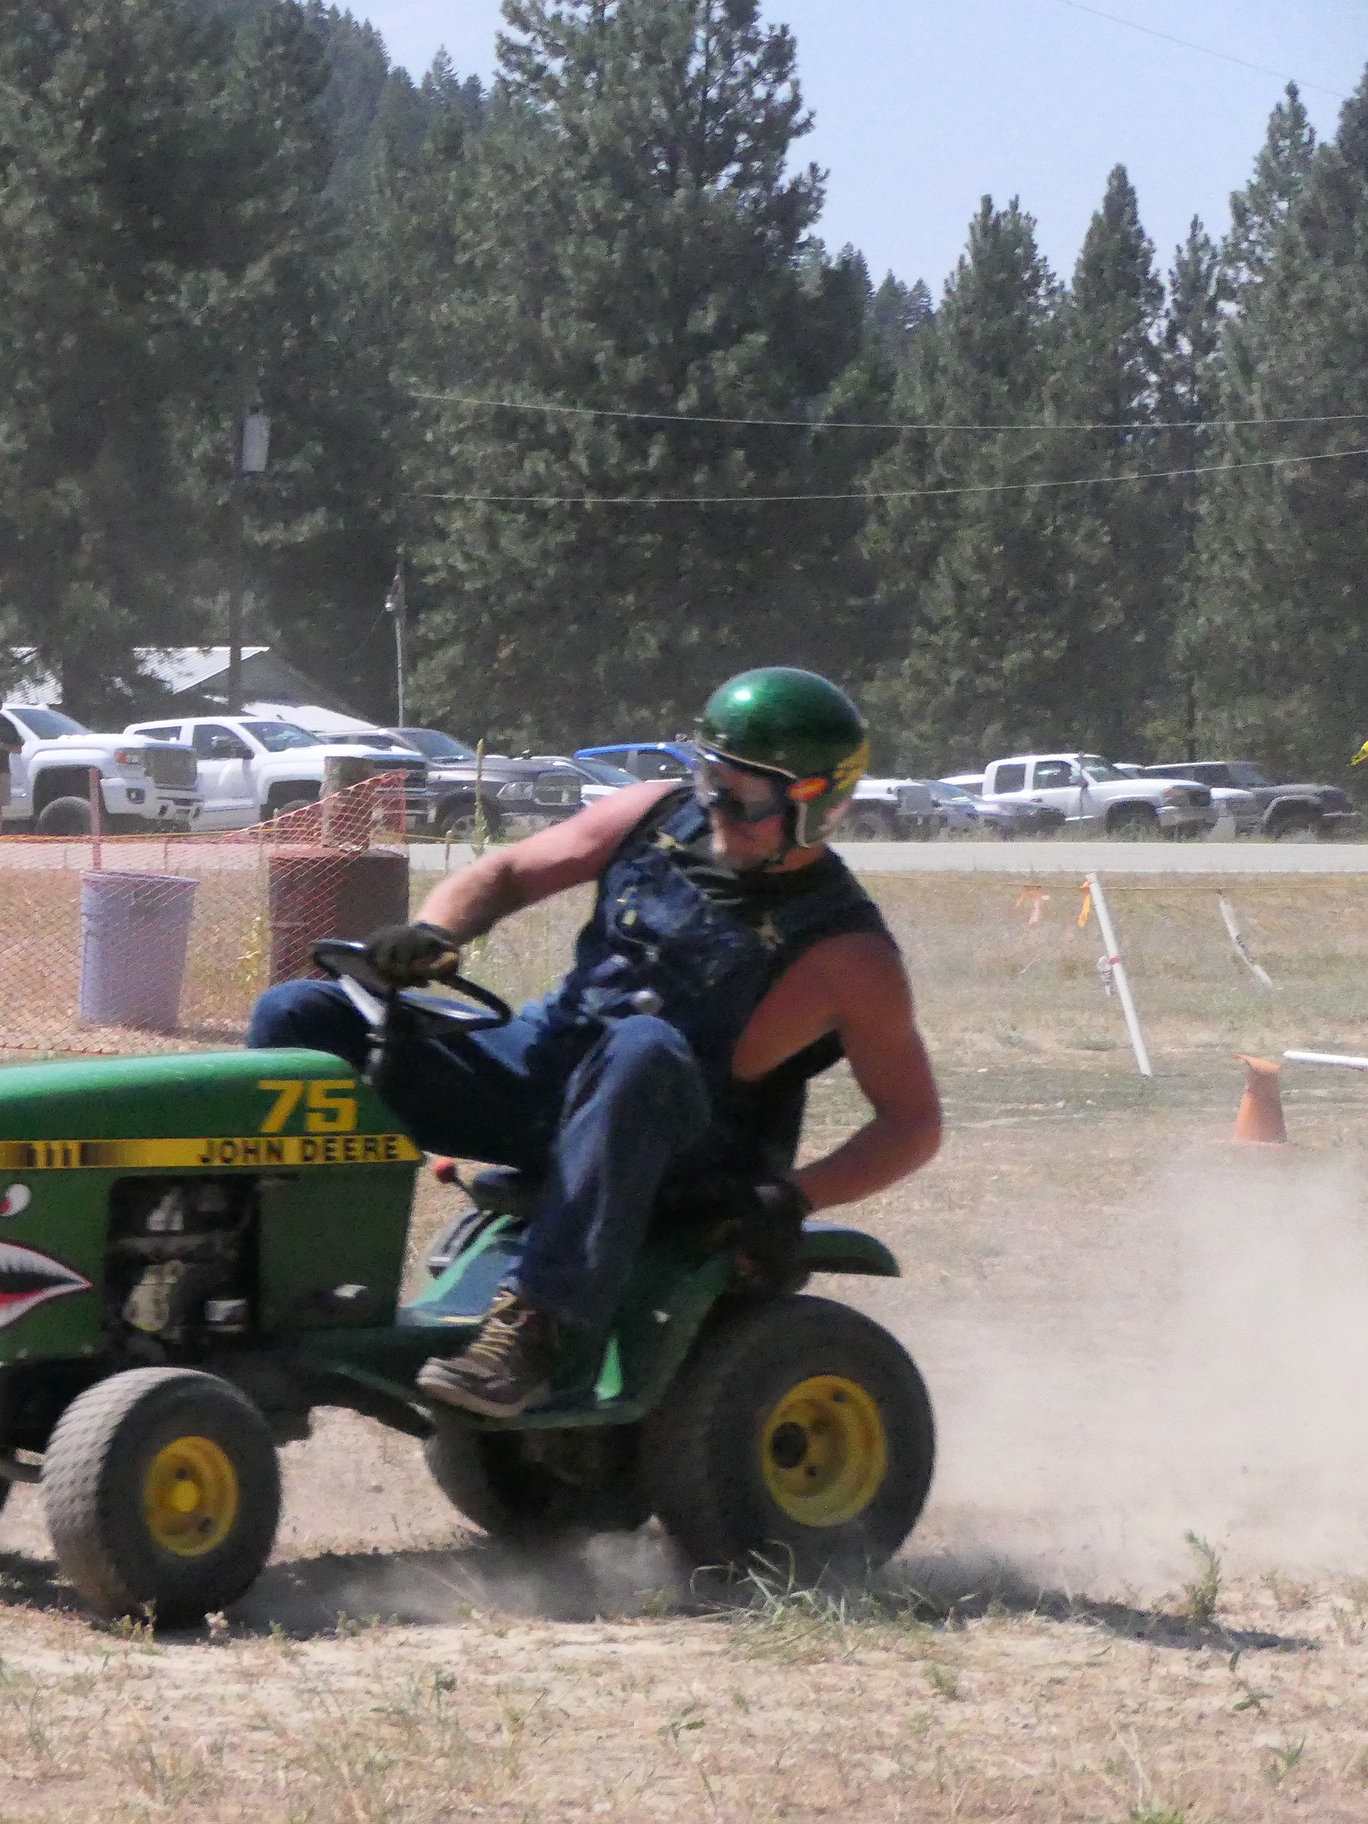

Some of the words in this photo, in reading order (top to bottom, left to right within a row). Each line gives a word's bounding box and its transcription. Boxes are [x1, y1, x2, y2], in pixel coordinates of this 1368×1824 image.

[258, 1080, 358, 1133] 75
[197, 1138, 285, 1165] JOHN
[299, 1135, 399, 1162] DEERE
